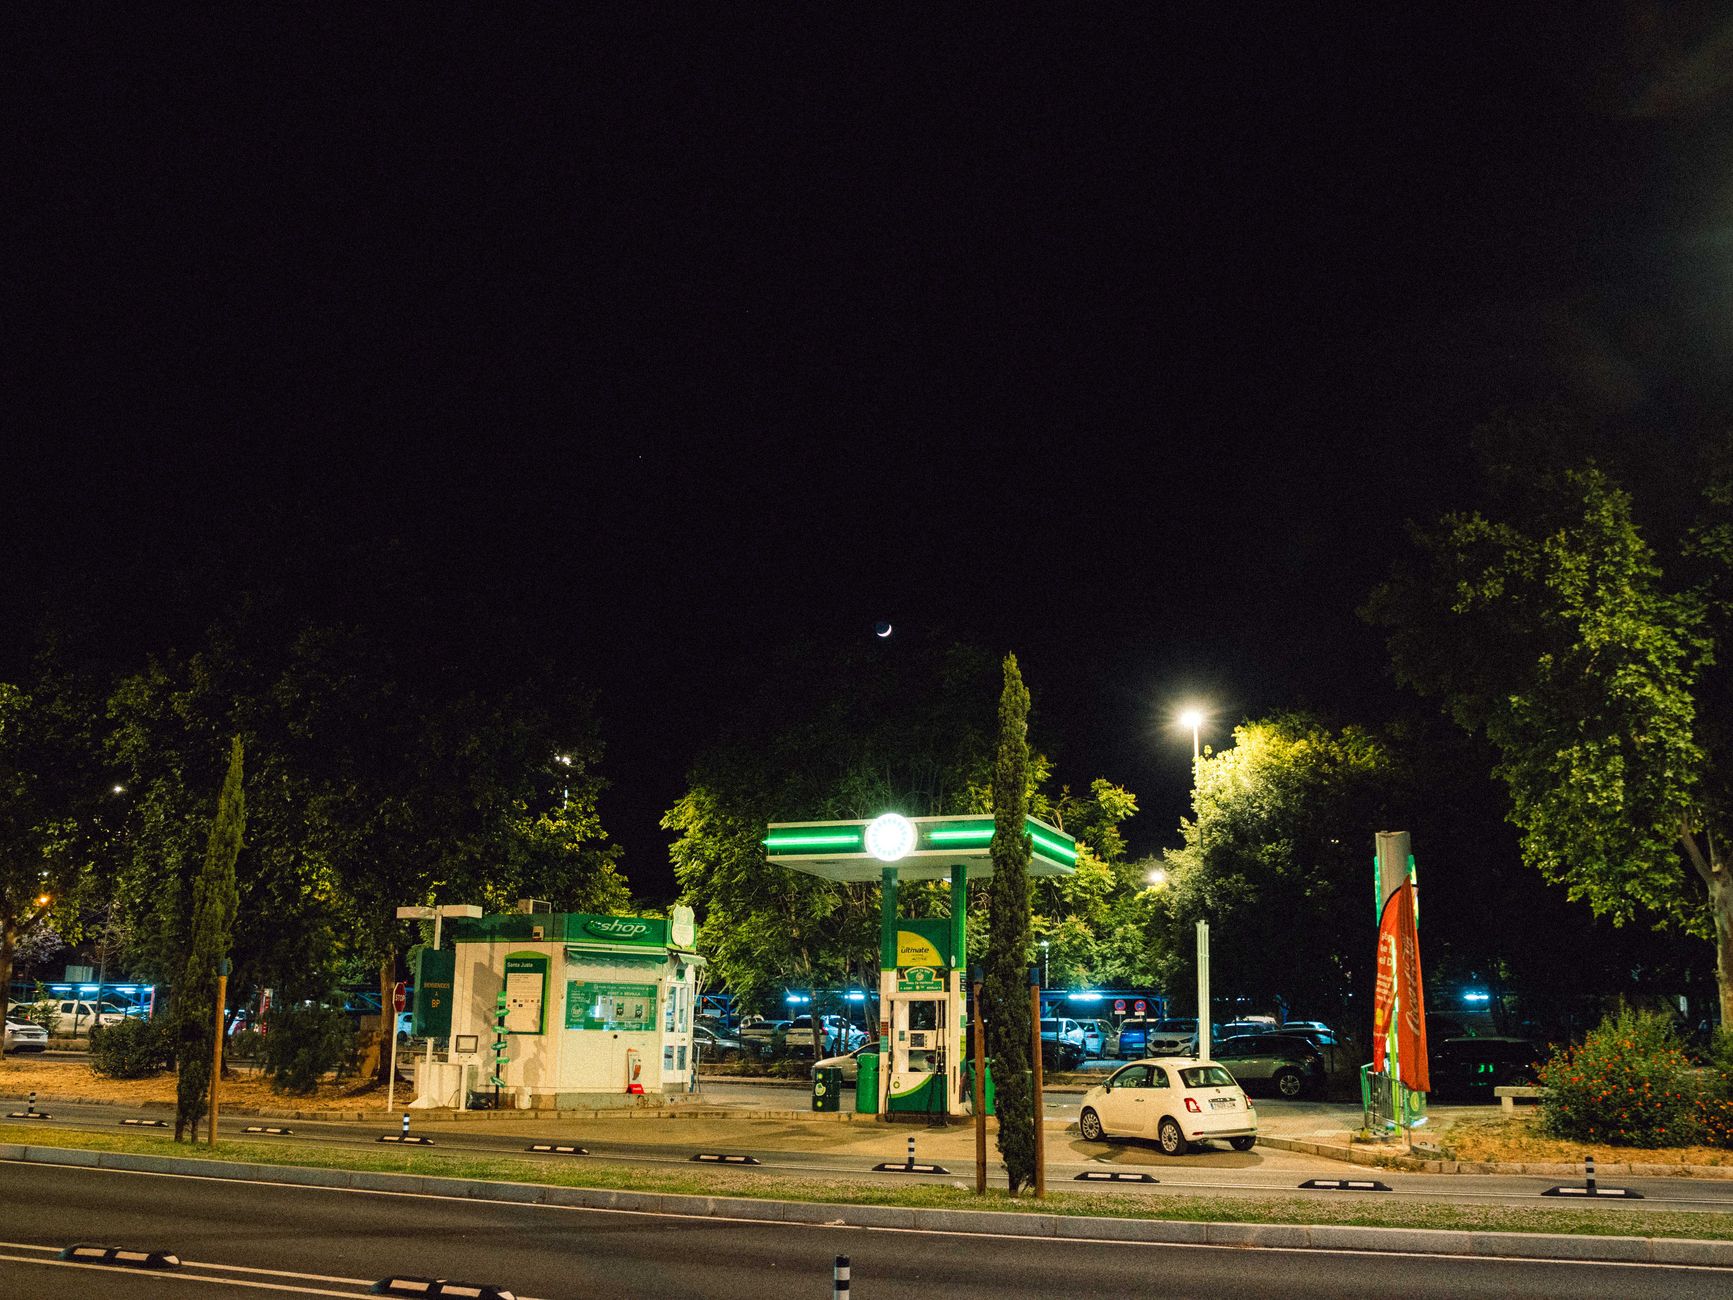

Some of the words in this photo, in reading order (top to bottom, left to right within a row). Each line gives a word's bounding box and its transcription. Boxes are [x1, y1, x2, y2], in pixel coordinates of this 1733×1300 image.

[600, 919, 647, 937] shop
[395, 993, 406, 1002] STOP
[431, 998, 441, 1008] BP
